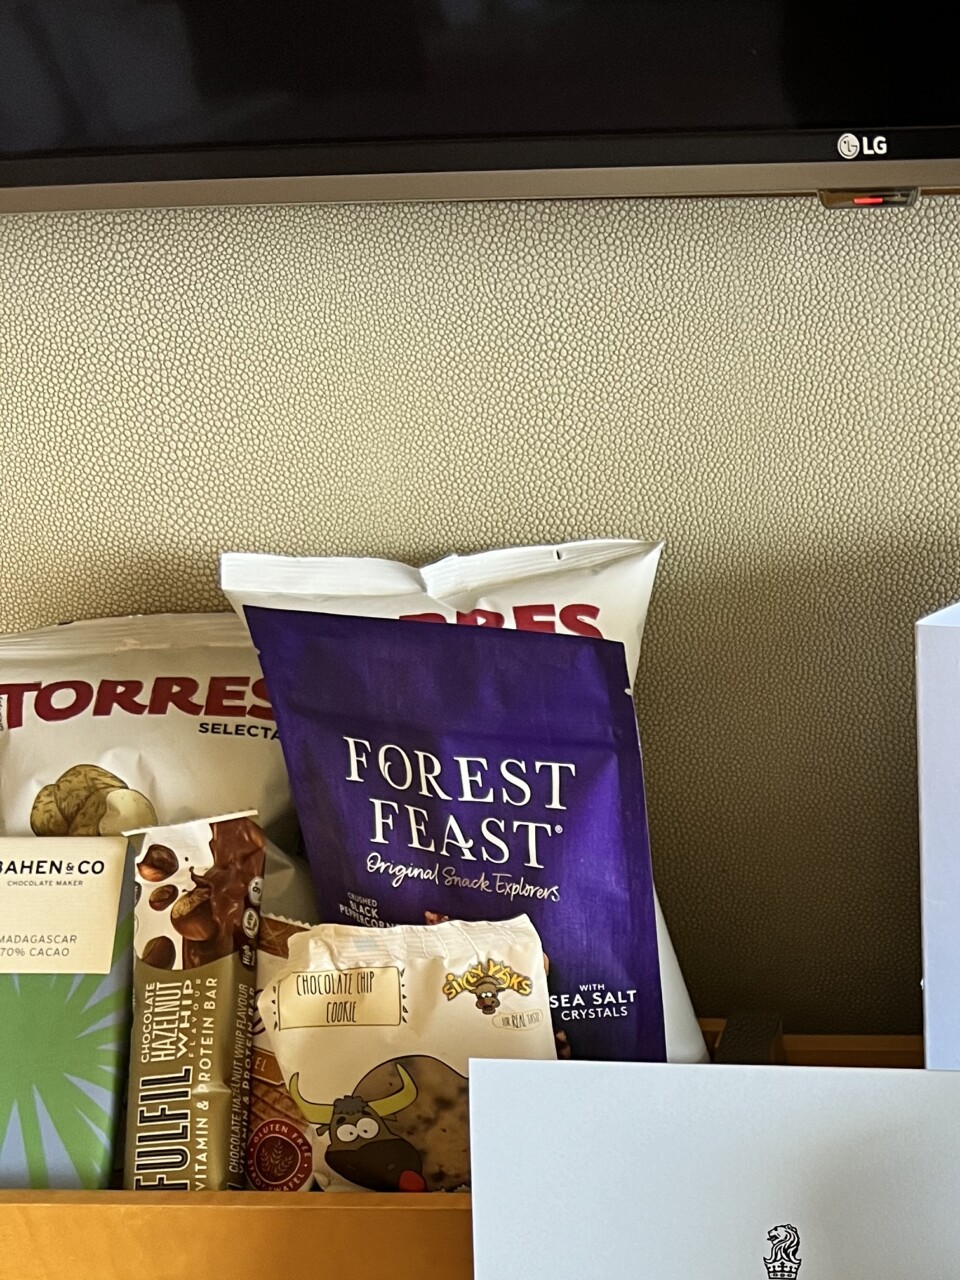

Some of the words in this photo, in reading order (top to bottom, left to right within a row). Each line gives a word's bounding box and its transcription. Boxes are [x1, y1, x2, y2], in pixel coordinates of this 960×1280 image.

[862, 136, 887, 155] LG
[343, 736, 576, 810] FOREST
[369, 798, 552, 868] FEAST
[0, 860, 62, 875] AHEN
[366, 852, 440, 887] Original
[442, 867, 492, 892] Snack
[492, 873, 561, 902] Explorers
[349, 900, 379, 919] BLACK
[29, 947, 70, 957] CACAO
[203, 977, 217, 1010] BAR
[296, 973, 352, 996] CHOCOLATE
[357, 972, 375, 995] CHIP
[549, 994, 585, 1008] SEA
[592, 990, 637, 1005] SALT
[579, 983, 605, 991] WITH
[140, 982, 155, 1063] CHOCOLATE
[151, 982, 182, 1062] HAZELNUT
[177, 980, 194, 1058] WHIP
[189, 979, 201, 1058] FLAVOUR
[237, 984, 249, 1029] FLAVOUR
[326, 1000, 357, 1024] COOKIE
[561, 1006, 628, 1021] CRYSTALS
[197, 1017, 214, 1093] PROTEIN
[234, 1030, 246, 1059] WHIP
[196, 1100, 209, 1110] &
[231, 1060, 244, 1112] HAZELNUT
[134, 1065, 194, 1190] FULFIL
[229, 1114, 241, 1173] CHOCOLATE
[254, 1124, 289, 1143] GLUTEN
[292, 1131, 312, 1158] FREE
[194, 1117, 209, 1190] VITAMIN
